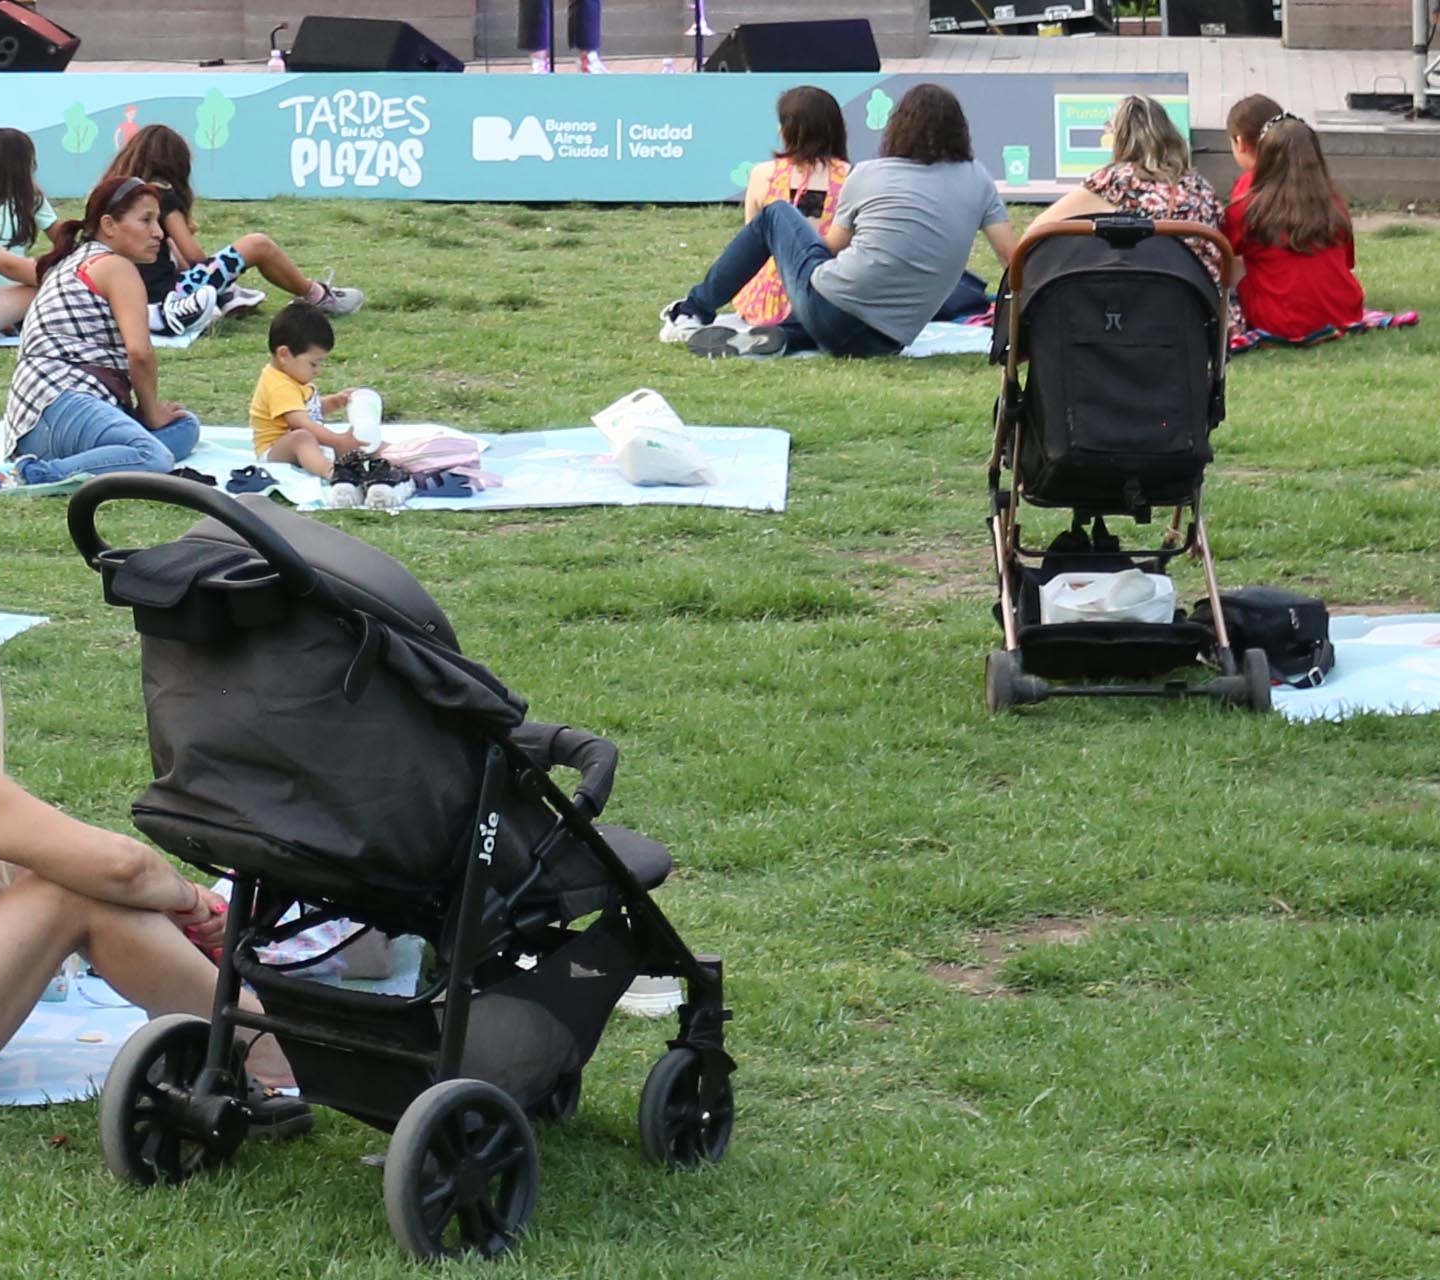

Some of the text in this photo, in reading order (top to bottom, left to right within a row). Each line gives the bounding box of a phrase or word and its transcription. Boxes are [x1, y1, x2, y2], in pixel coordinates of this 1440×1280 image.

[278, 89, 431, 136] TARDES
[340, 126, 385, 138] EN LAS
[472, 115, 693, 162] BA Buenos Ciudad
[553, 132, 593, 145] Aires
[291, 137, 424, 188] PLAZAS
[558, 144, 609, 158] Ciudad
[628, 141, 684, 158] Verde
[478, 811, 500, 866] Joie
